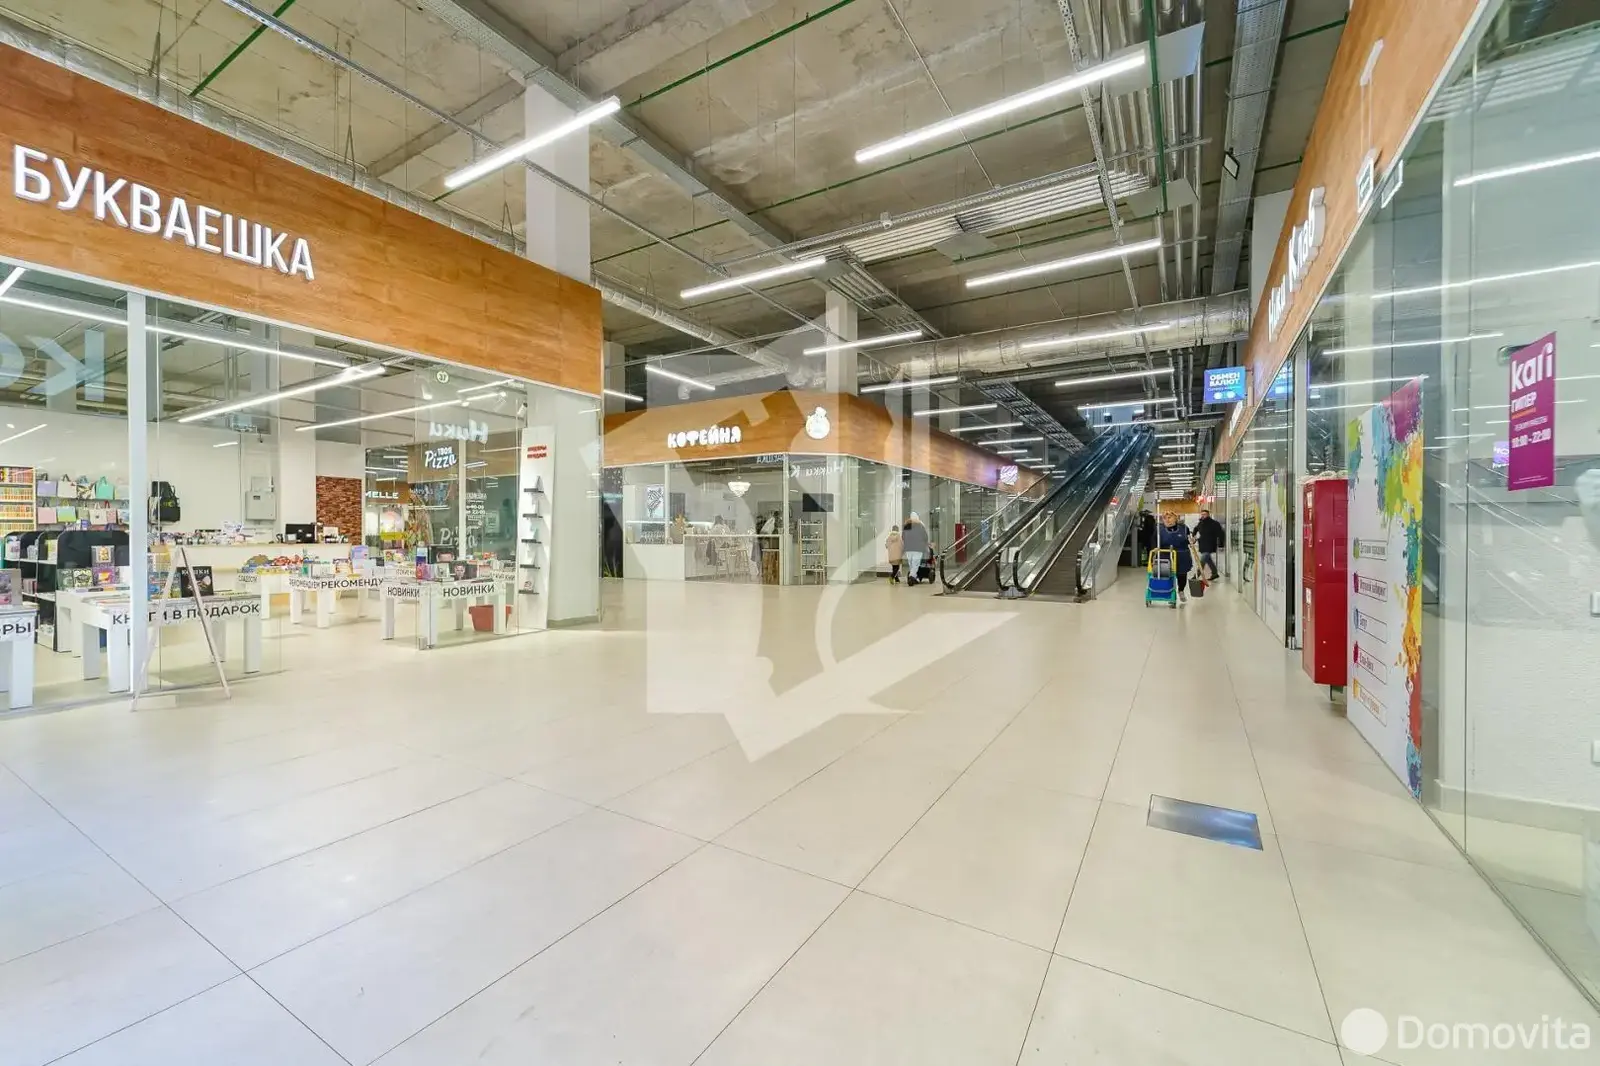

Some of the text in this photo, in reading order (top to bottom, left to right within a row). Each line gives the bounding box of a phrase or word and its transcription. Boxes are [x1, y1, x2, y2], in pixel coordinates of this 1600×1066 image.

[14, 144, 315, 281] БУКВАЕШКА
[1511, 342, 1554, 392] kari
[667, 424, 742, 449] КОФЕЙНЯ
[425, 450, 457, 468] Pizza
[387, 586, 420, 598] НОВИНКИ
[443, 584, 495, 598] НОВИНКИ
[172, 609, 182, 620] В
